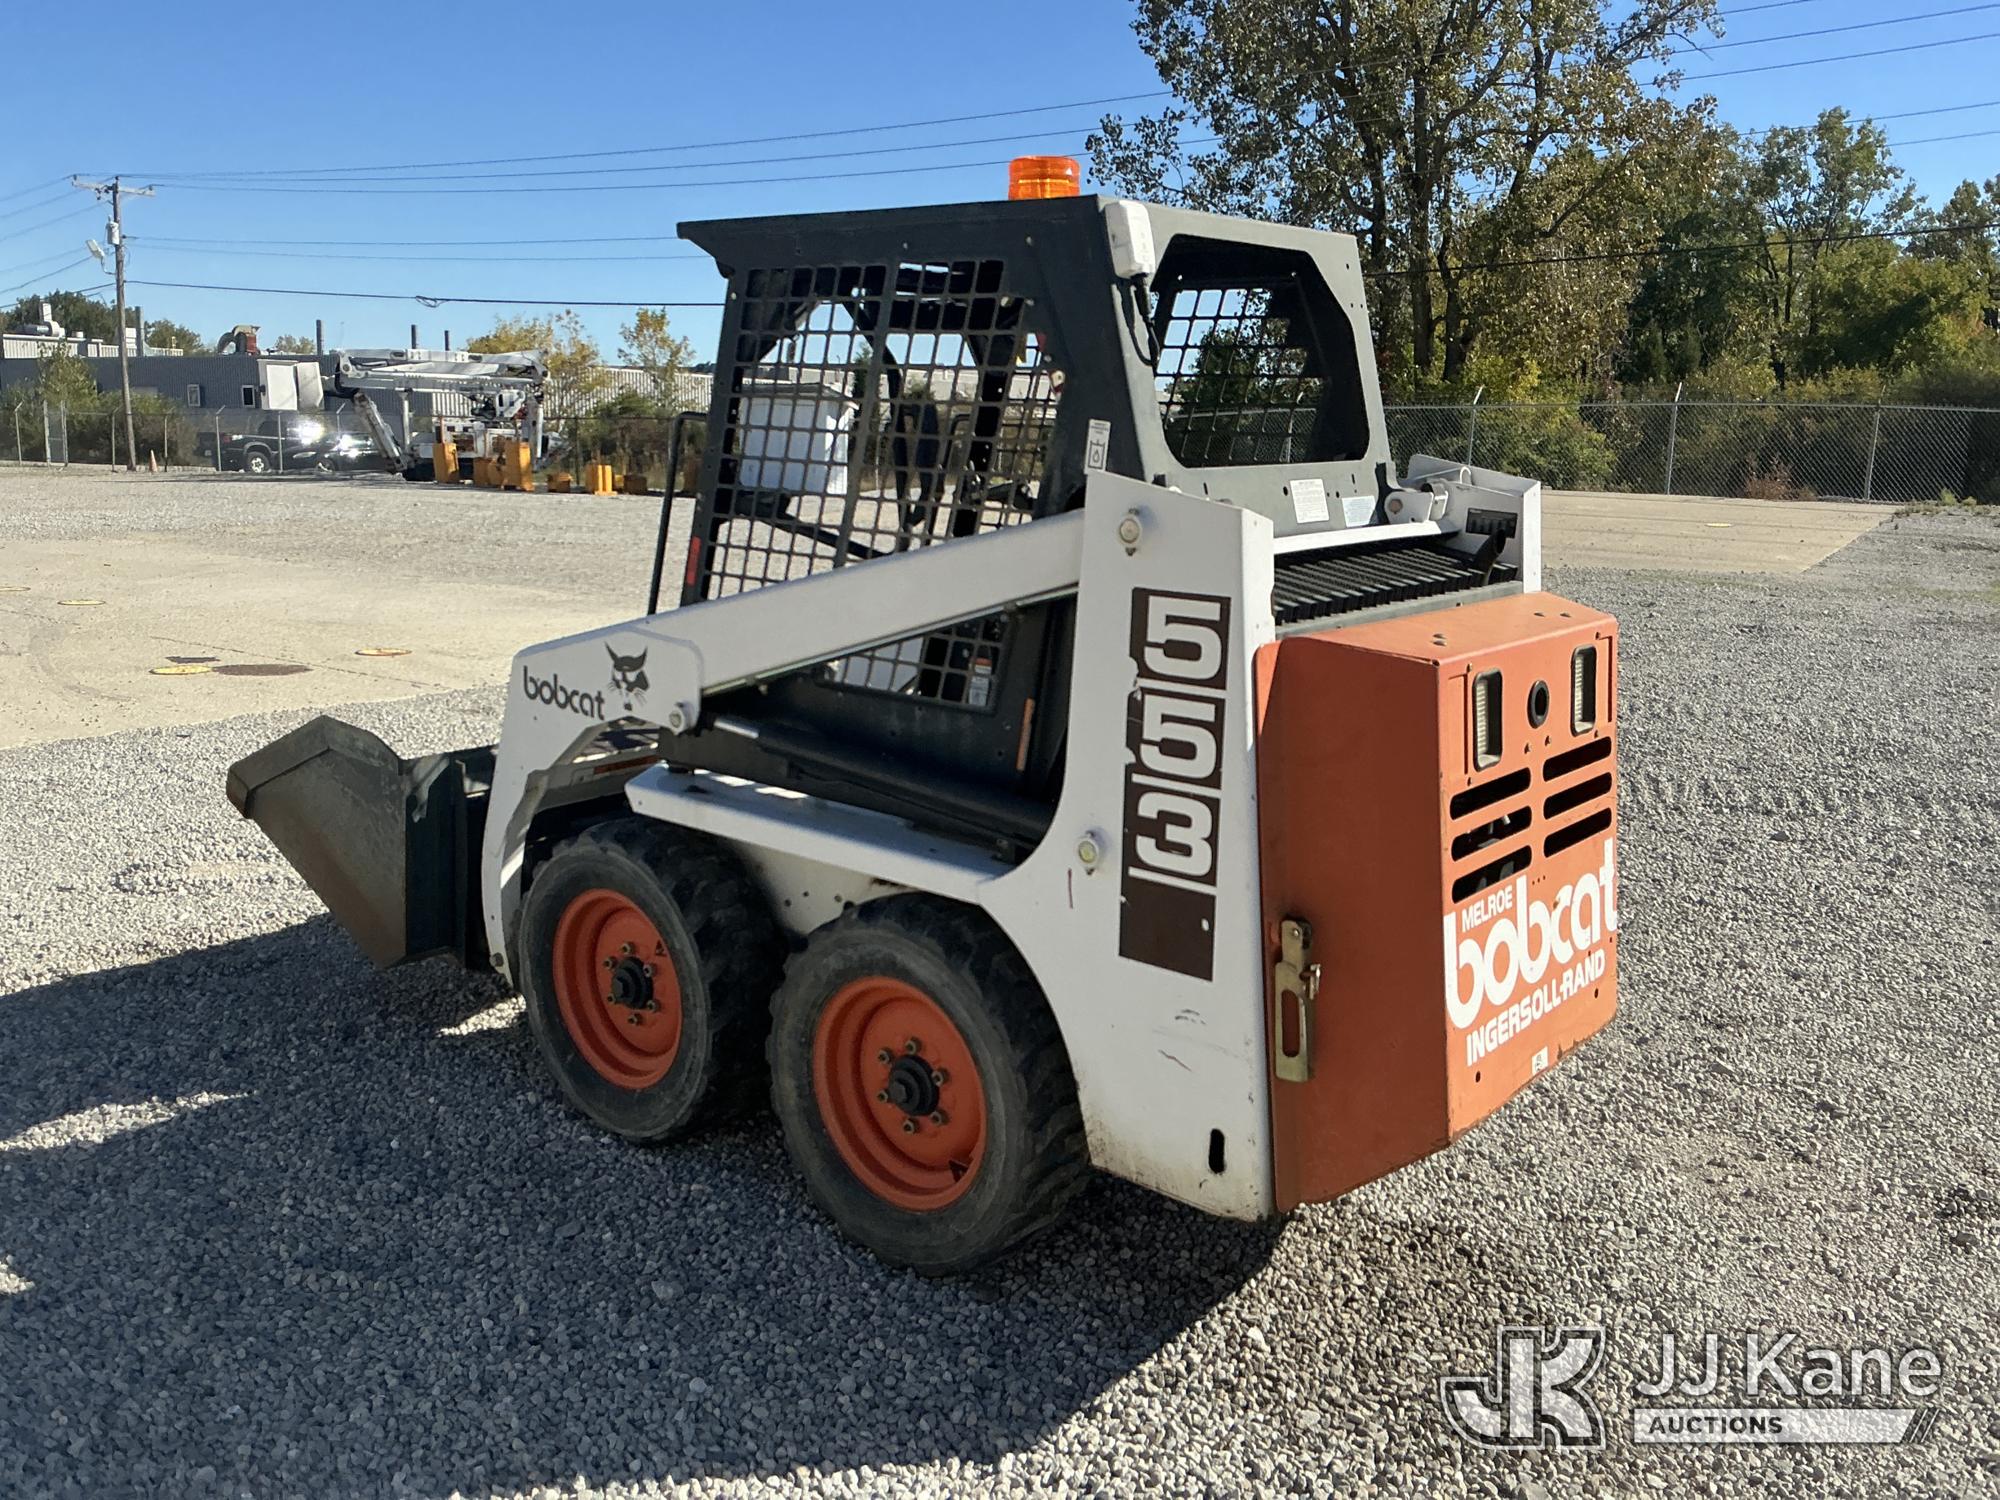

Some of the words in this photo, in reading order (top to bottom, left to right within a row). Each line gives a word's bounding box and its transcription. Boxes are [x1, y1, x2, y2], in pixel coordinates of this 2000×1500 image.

[523, 665, 606, 720] bobcat
[1135, 595, 1222, 877] 553
[1443, 837, 1617, 1029] bobcat
[1461, 885, 1513, 933] MELROE
[1466, 949, 1606, 1067] INGERSOLL-RAND
